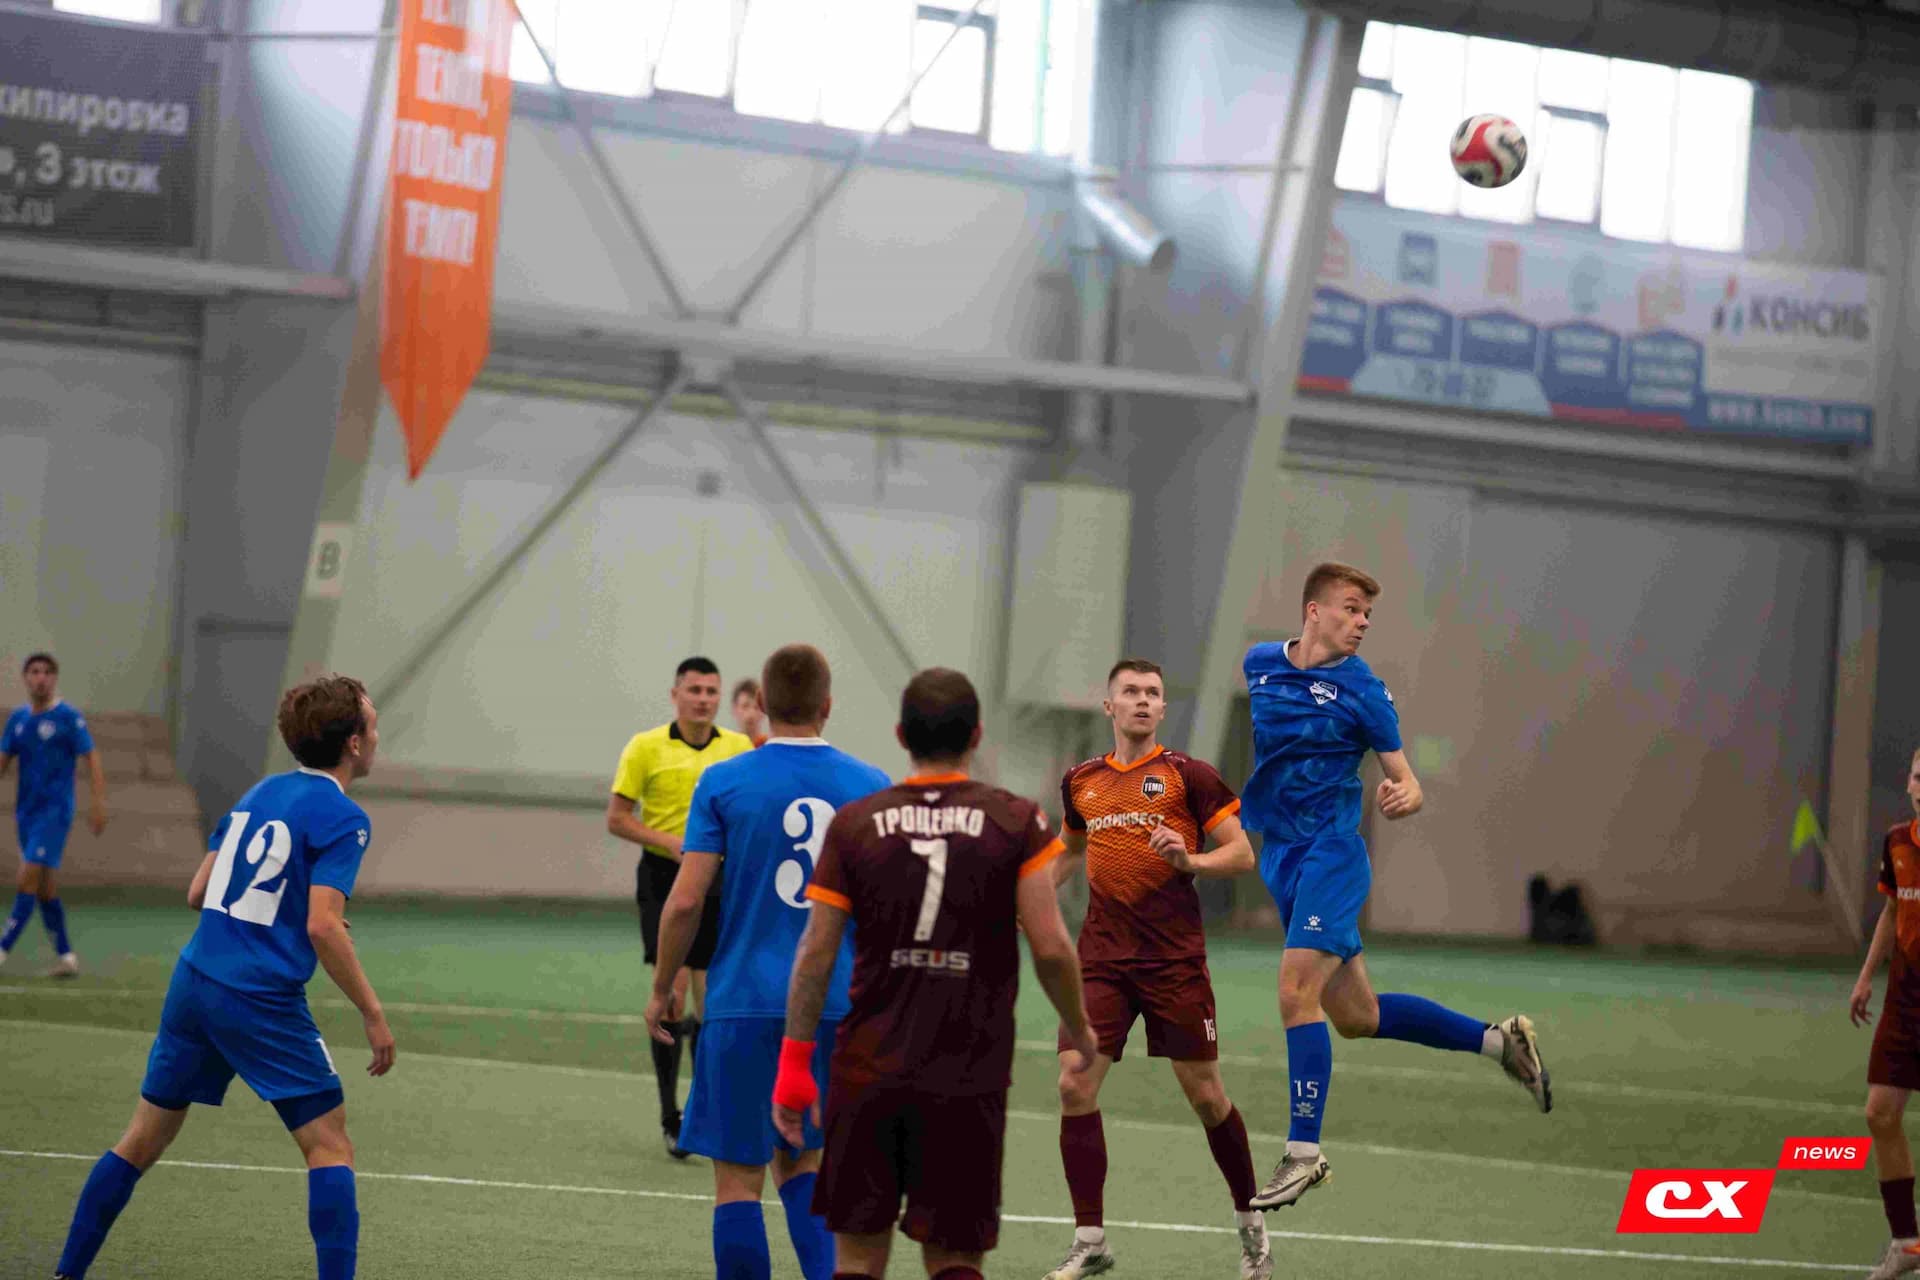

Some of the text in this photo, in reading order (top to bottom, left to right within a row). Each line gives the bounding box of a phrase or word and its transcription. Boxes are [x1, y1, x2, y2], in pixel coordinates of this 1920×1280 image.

[69, 157, 161, 194] этаж
[1750, 295, 1870, 341] КОНСИБ
[872, 804, 985, 838] ТРОЦЕНКО
[202, 811, 293, 927] 12
[774, 796, 838, 910] 3
[910, 838, 949, 942] 7
[1293, 1079, 1320, 1100] 15
